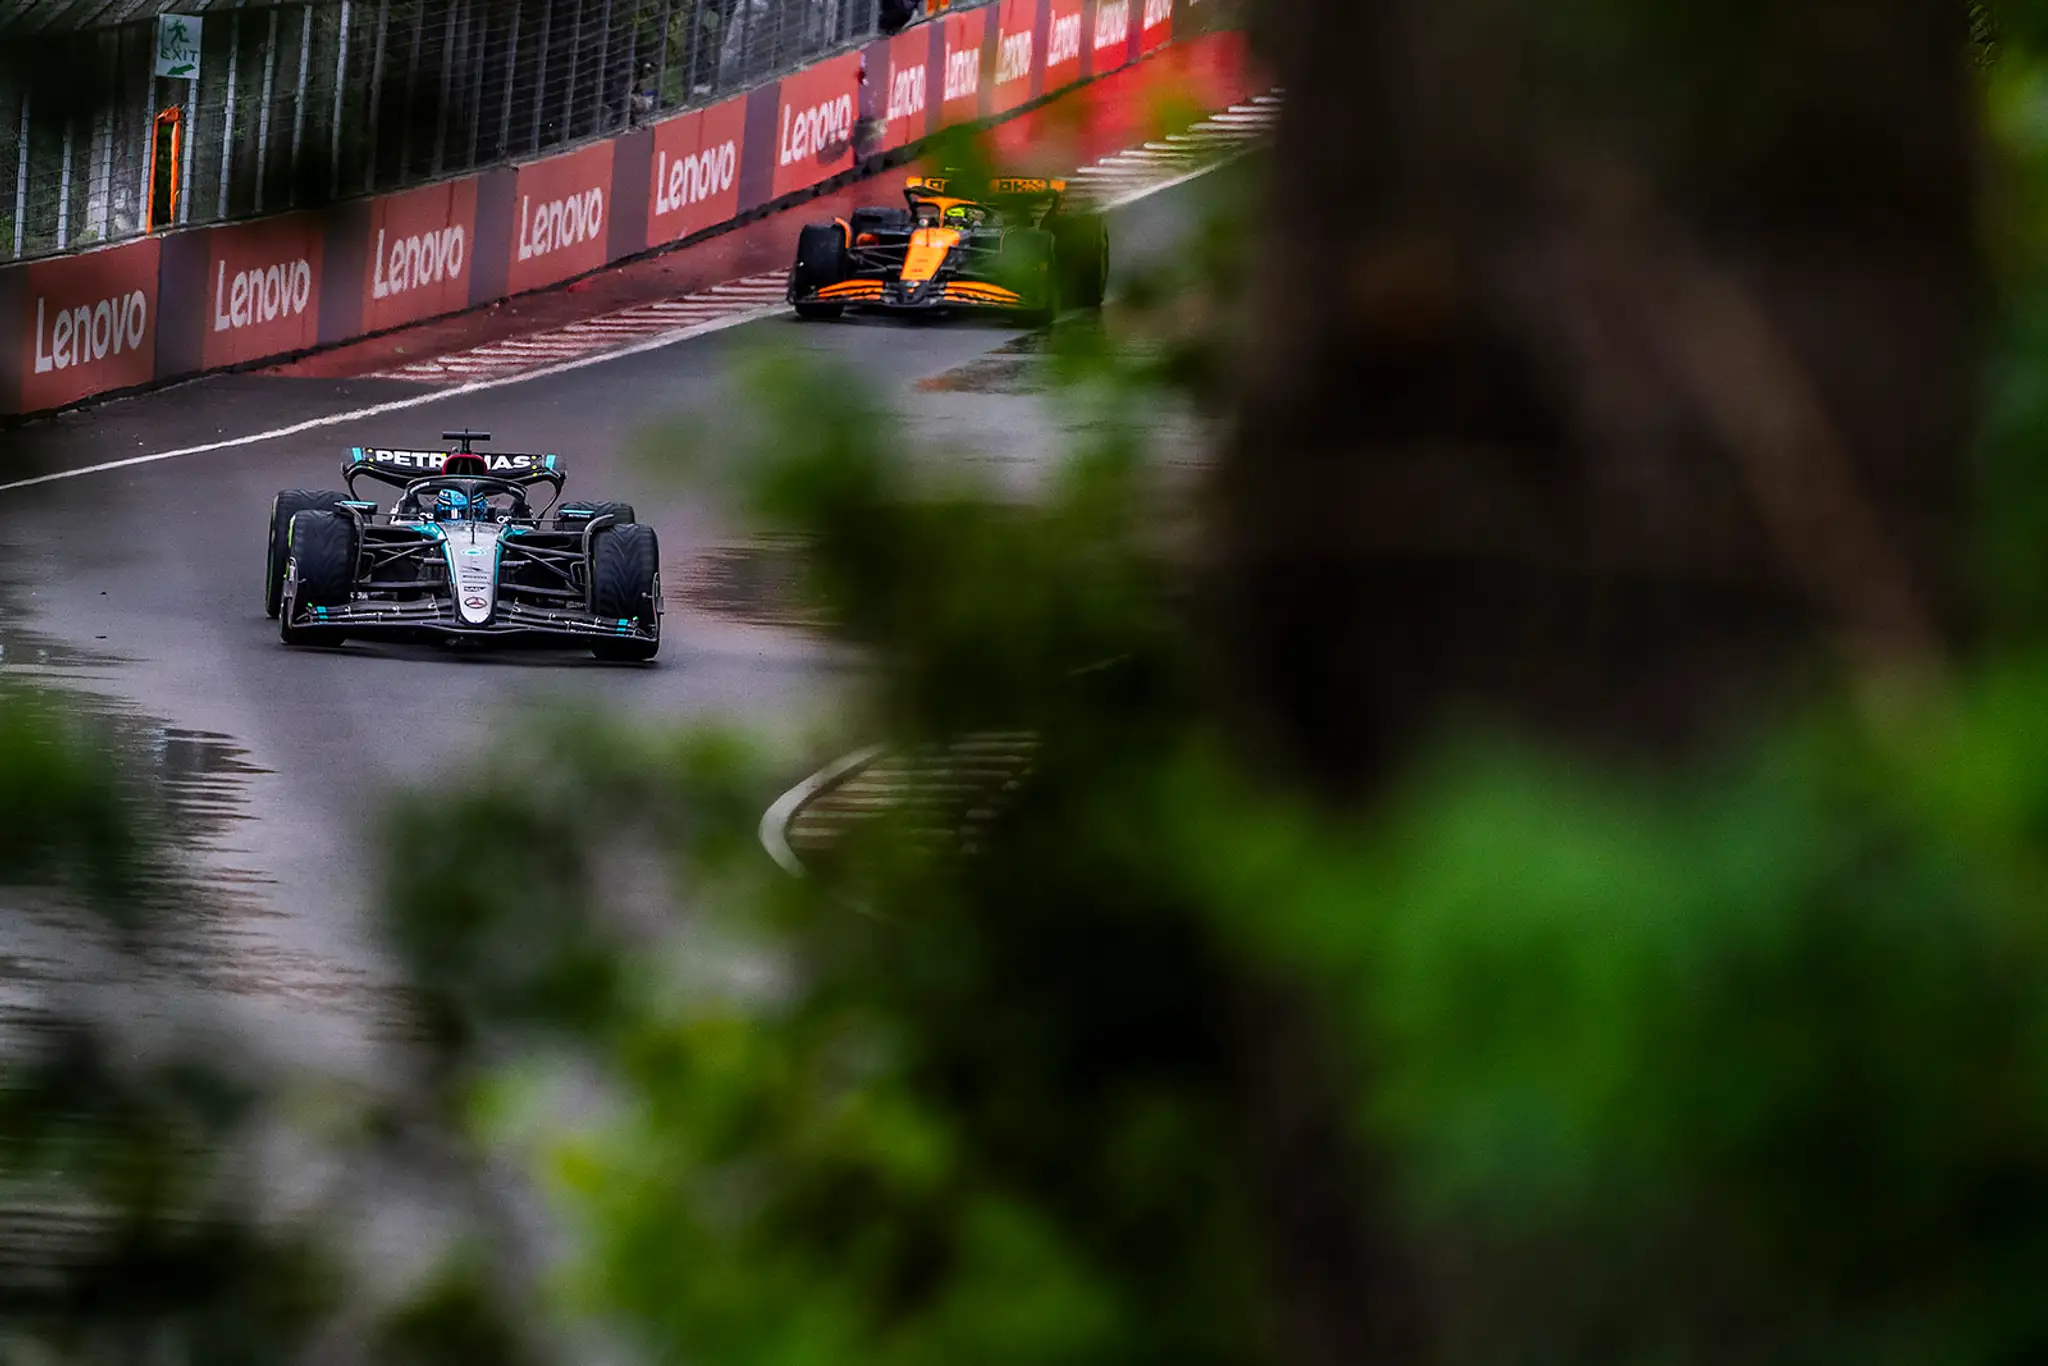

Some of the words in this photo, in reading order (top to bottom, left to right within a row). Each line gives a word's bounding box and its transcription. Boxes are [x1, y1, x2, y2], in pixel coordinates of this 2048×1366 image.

[160, 48, 199, 62] EXIT
[780, 93, 852, 167] Lenovo
[655, 140, 735, 216] Lenovo
[372, 224, 465, 299] Lenovo
[518, 187, 602, 262] Lenovo
[34, 289, 147, 374] Lenovo
[214, 257, 311, 332] Lenovo
[375, 449, 532, 470] PETRAS
